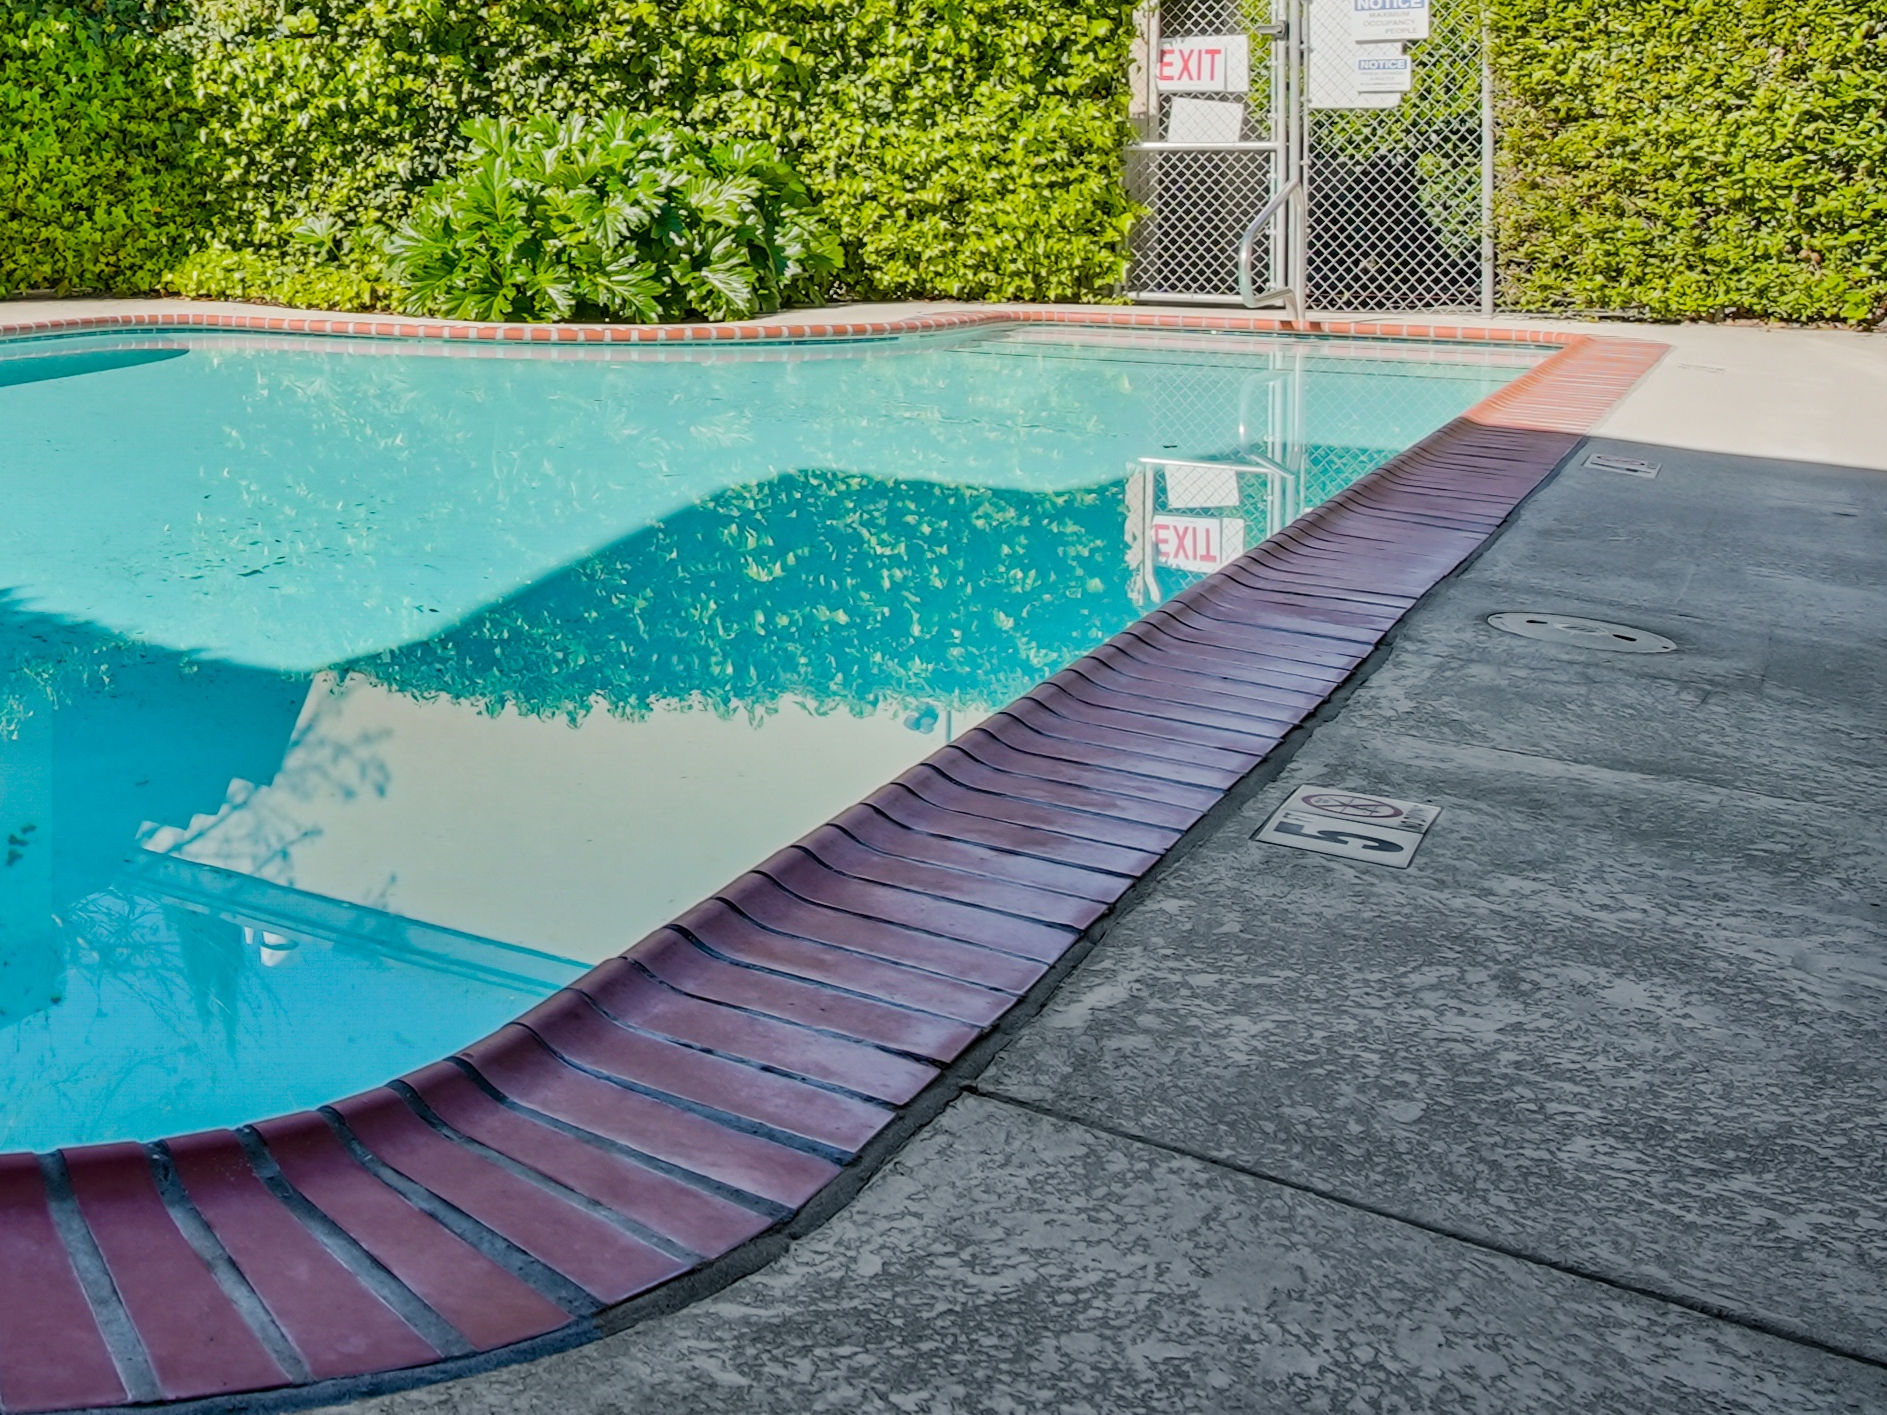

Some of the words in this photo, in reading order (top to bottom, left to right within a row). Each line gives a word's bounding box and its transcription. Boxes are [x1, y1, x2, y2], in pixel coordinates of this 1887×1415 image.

[1363, 19, 1415, 27] OCCUPANCY
[1158, 49, 1222, 81] EXIT
[1359, 59, 1406, 70] NOTICE
[1273, 821, 1404, 853] 5
